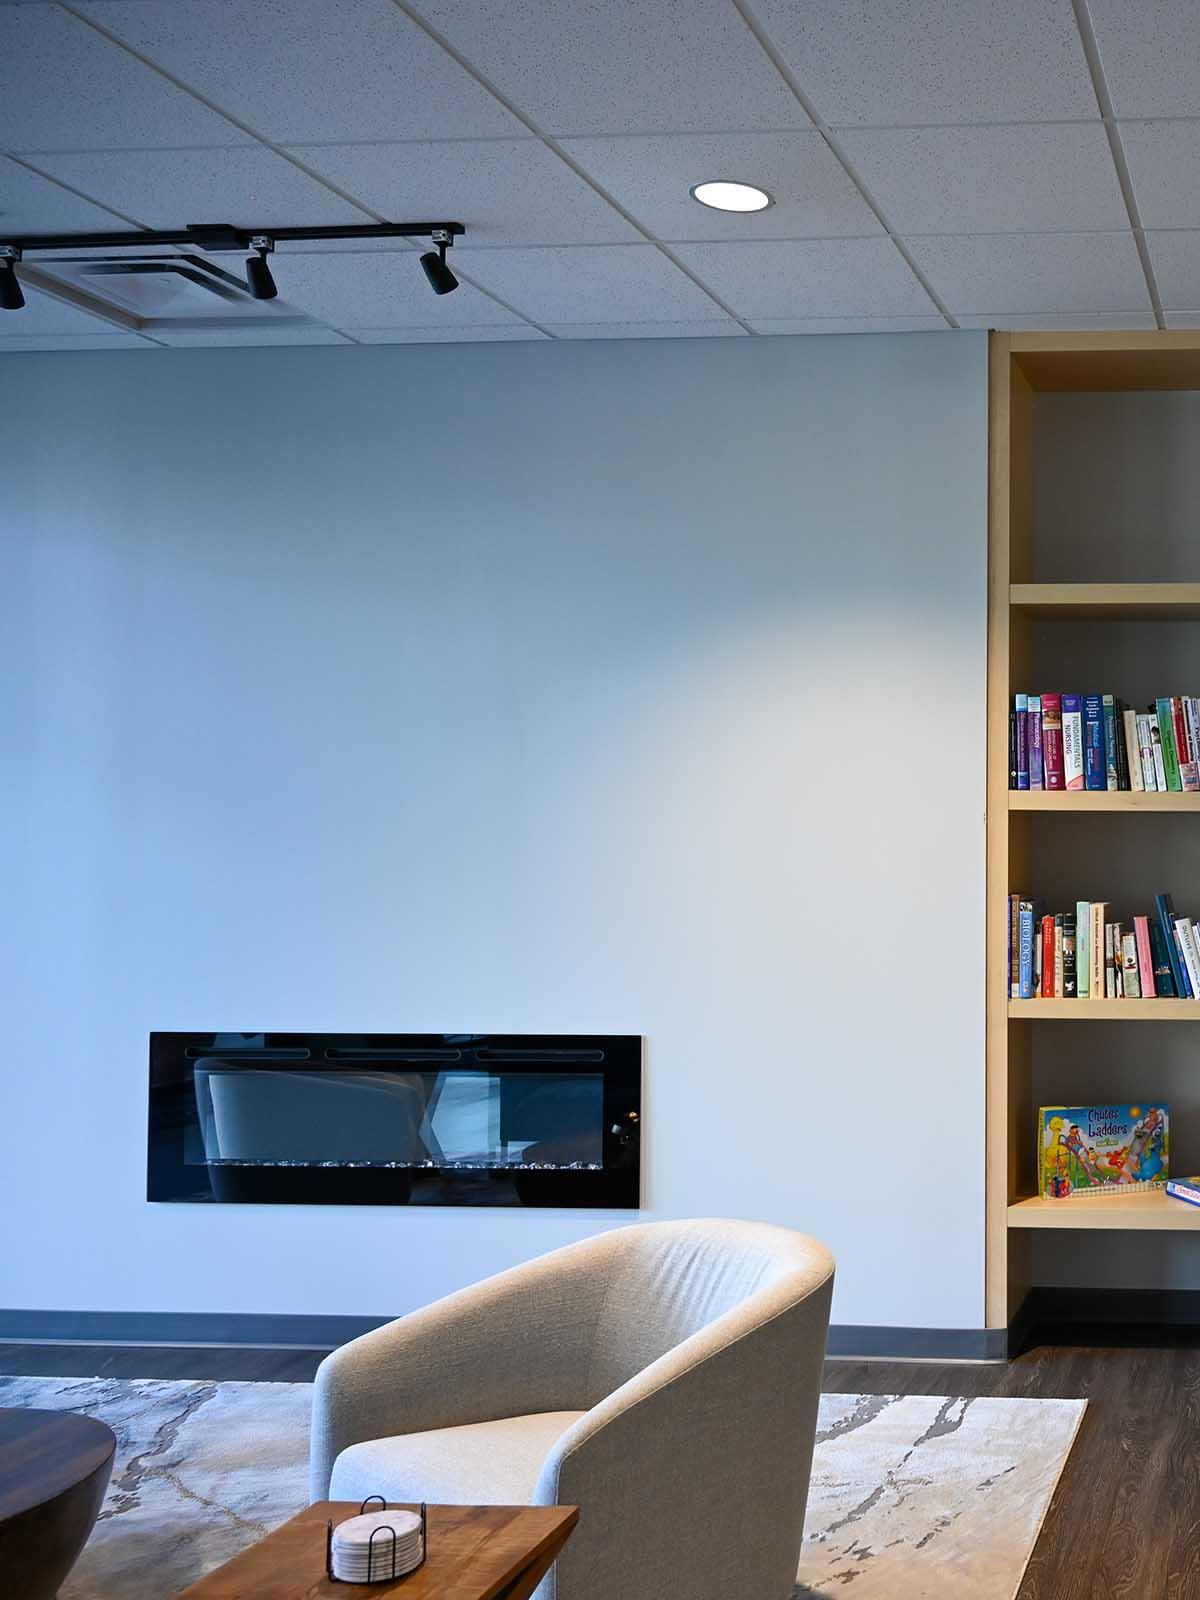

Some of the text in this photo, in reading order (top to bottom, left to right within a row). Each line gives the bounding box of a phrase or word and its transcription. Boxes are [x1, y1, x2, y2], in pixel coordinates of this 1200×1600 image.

[1064, 724, 1073, 755] NURSING
[1072, 716, 1081, 769] FUNDAMENTALS
[1022, 919, 1030, 966] BIOLOGY
[1182, 924, 1192, 951] OUTLIVE
[1088, 1109, 1119, 1122] Chutes
[1088, 1123, 1128, 1138] Ladders
